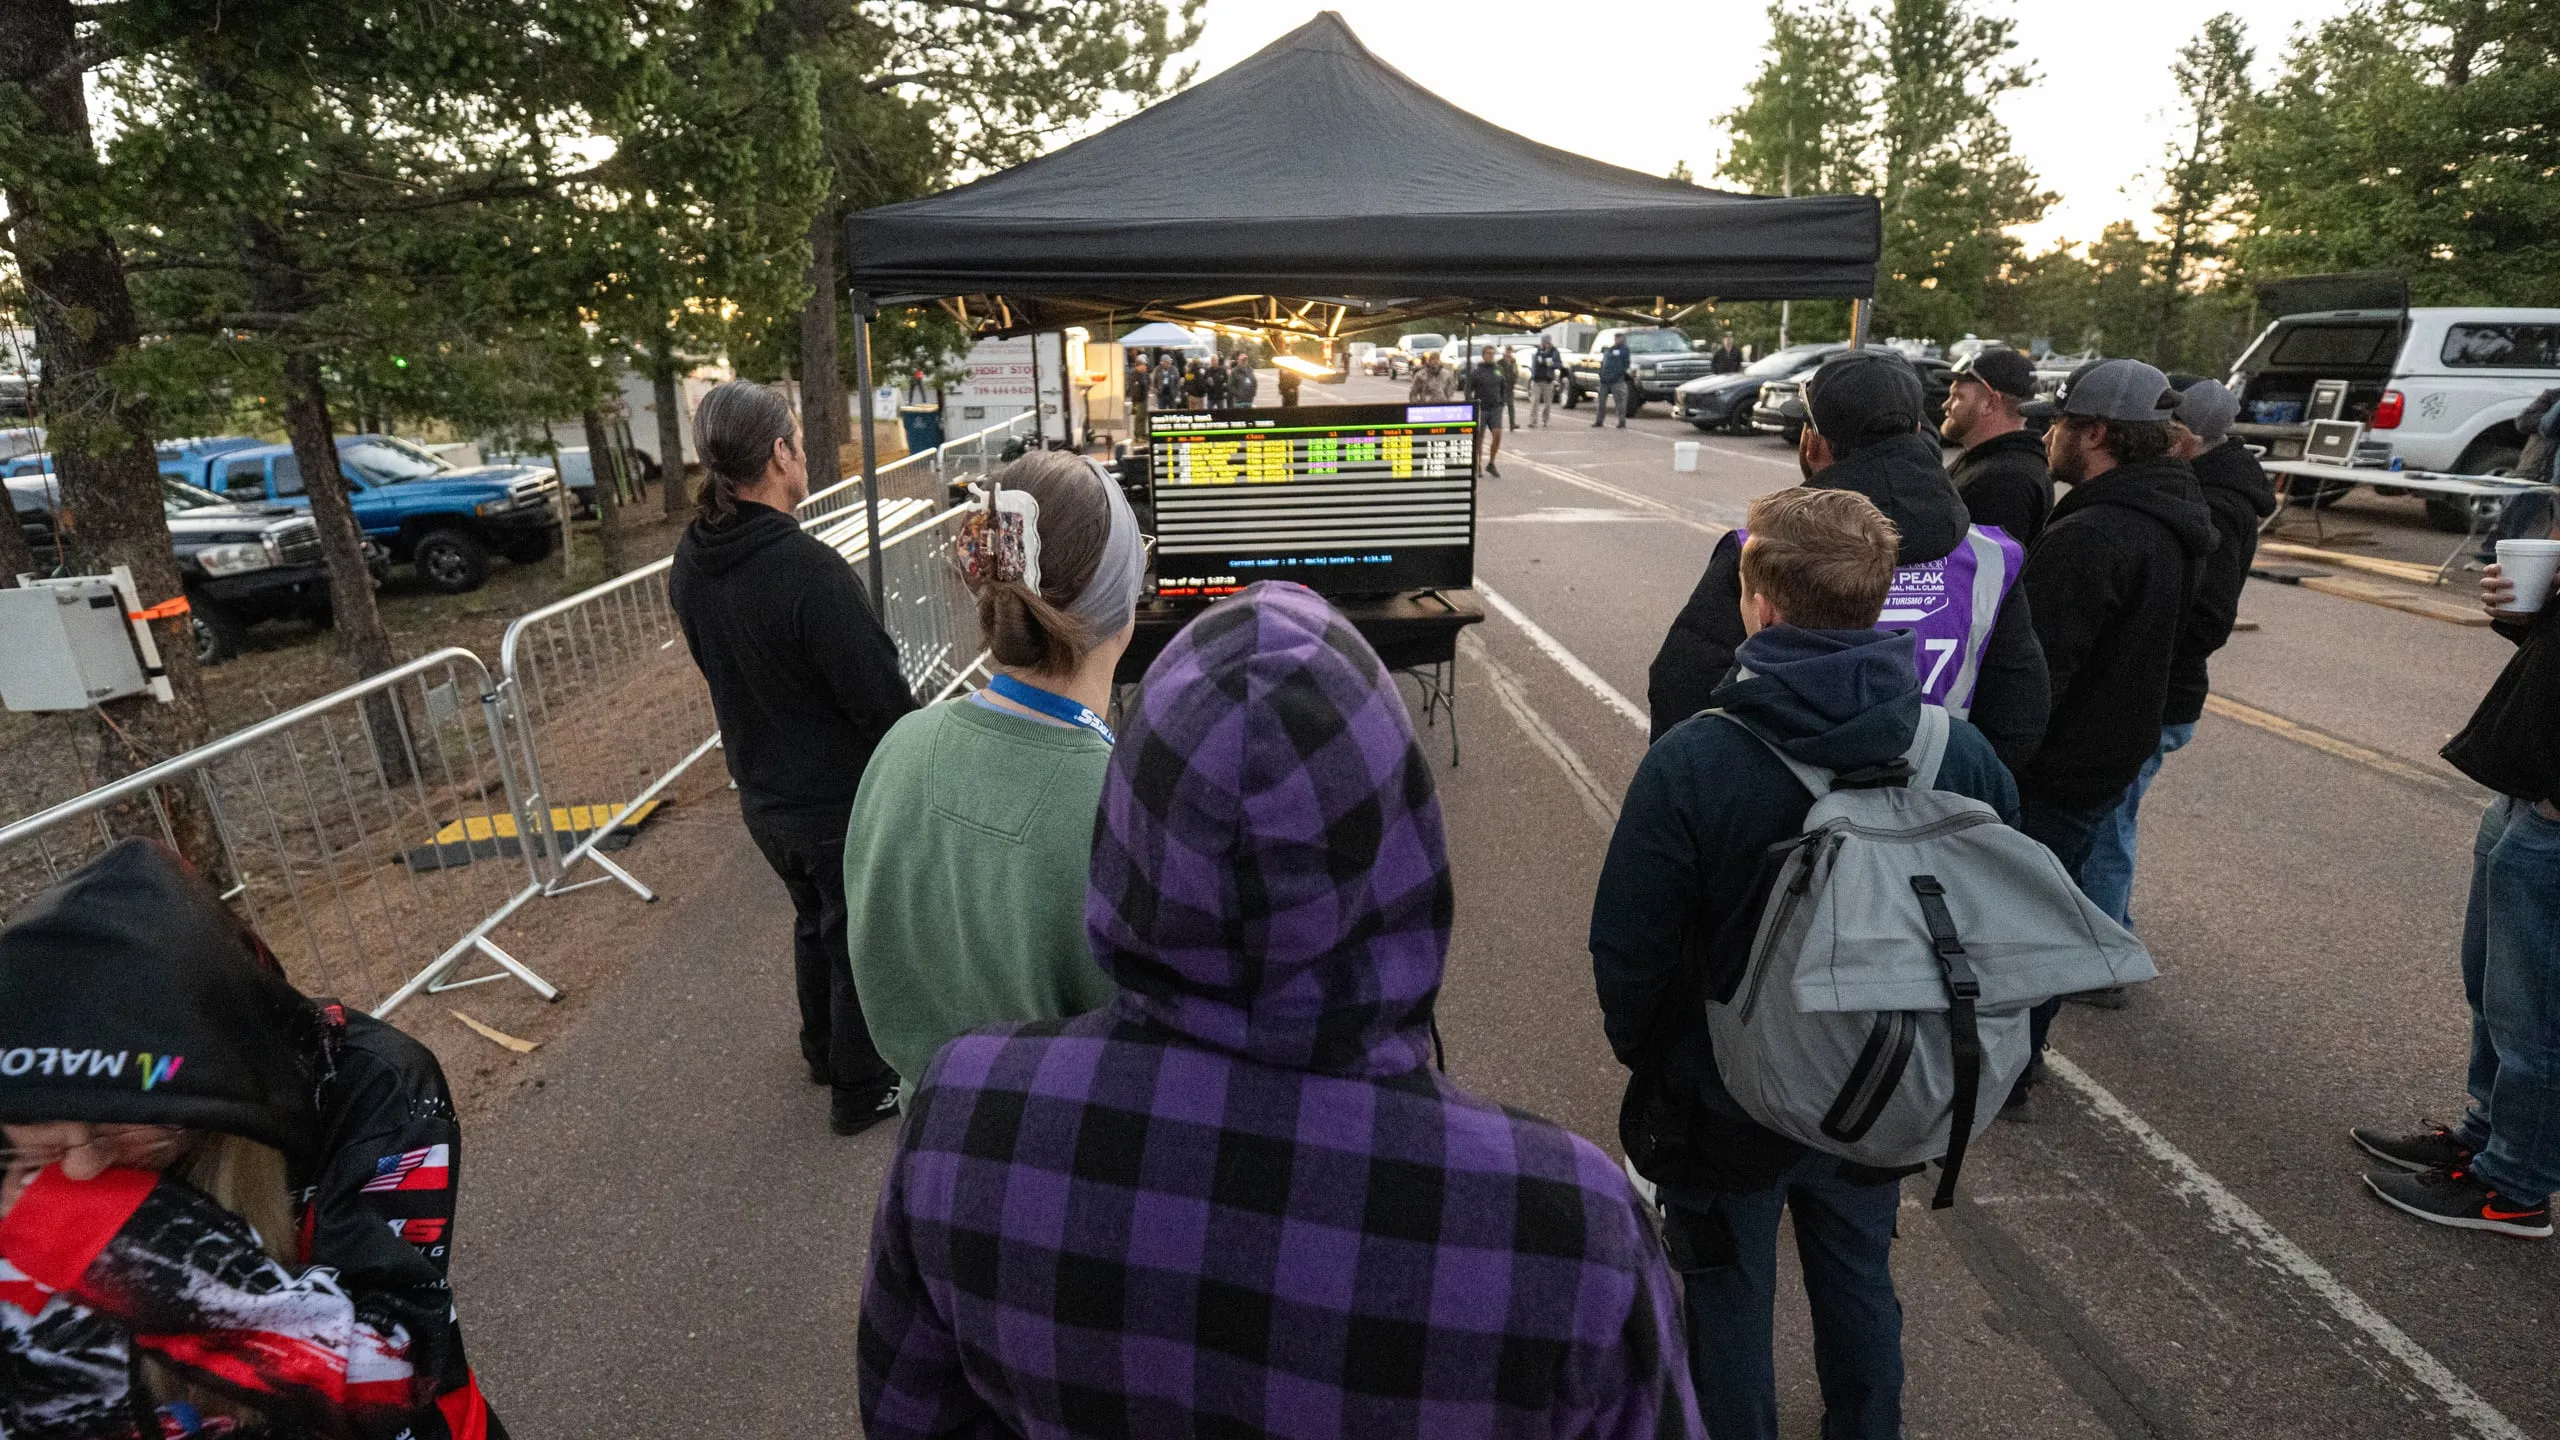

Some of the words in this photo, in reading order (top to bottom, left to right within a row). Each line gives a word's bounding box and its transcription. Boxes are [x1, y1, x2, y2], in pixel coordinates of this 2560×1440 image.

[974, 366, 1004, 375] HORT
[1010, 366, 1034, 375] STO
[1229, 559, 1255, 567] Current
[1257, 558, 1279, 567] Leader
[1177, 577, 1187, 586] of
[1899, 572, 1945, 584] PEAK
[1891, 597, 1923, 605] TURISMO
[1921, 638, 1958, 695] 7
[0, 1047, 130, 1077] MAŁO
